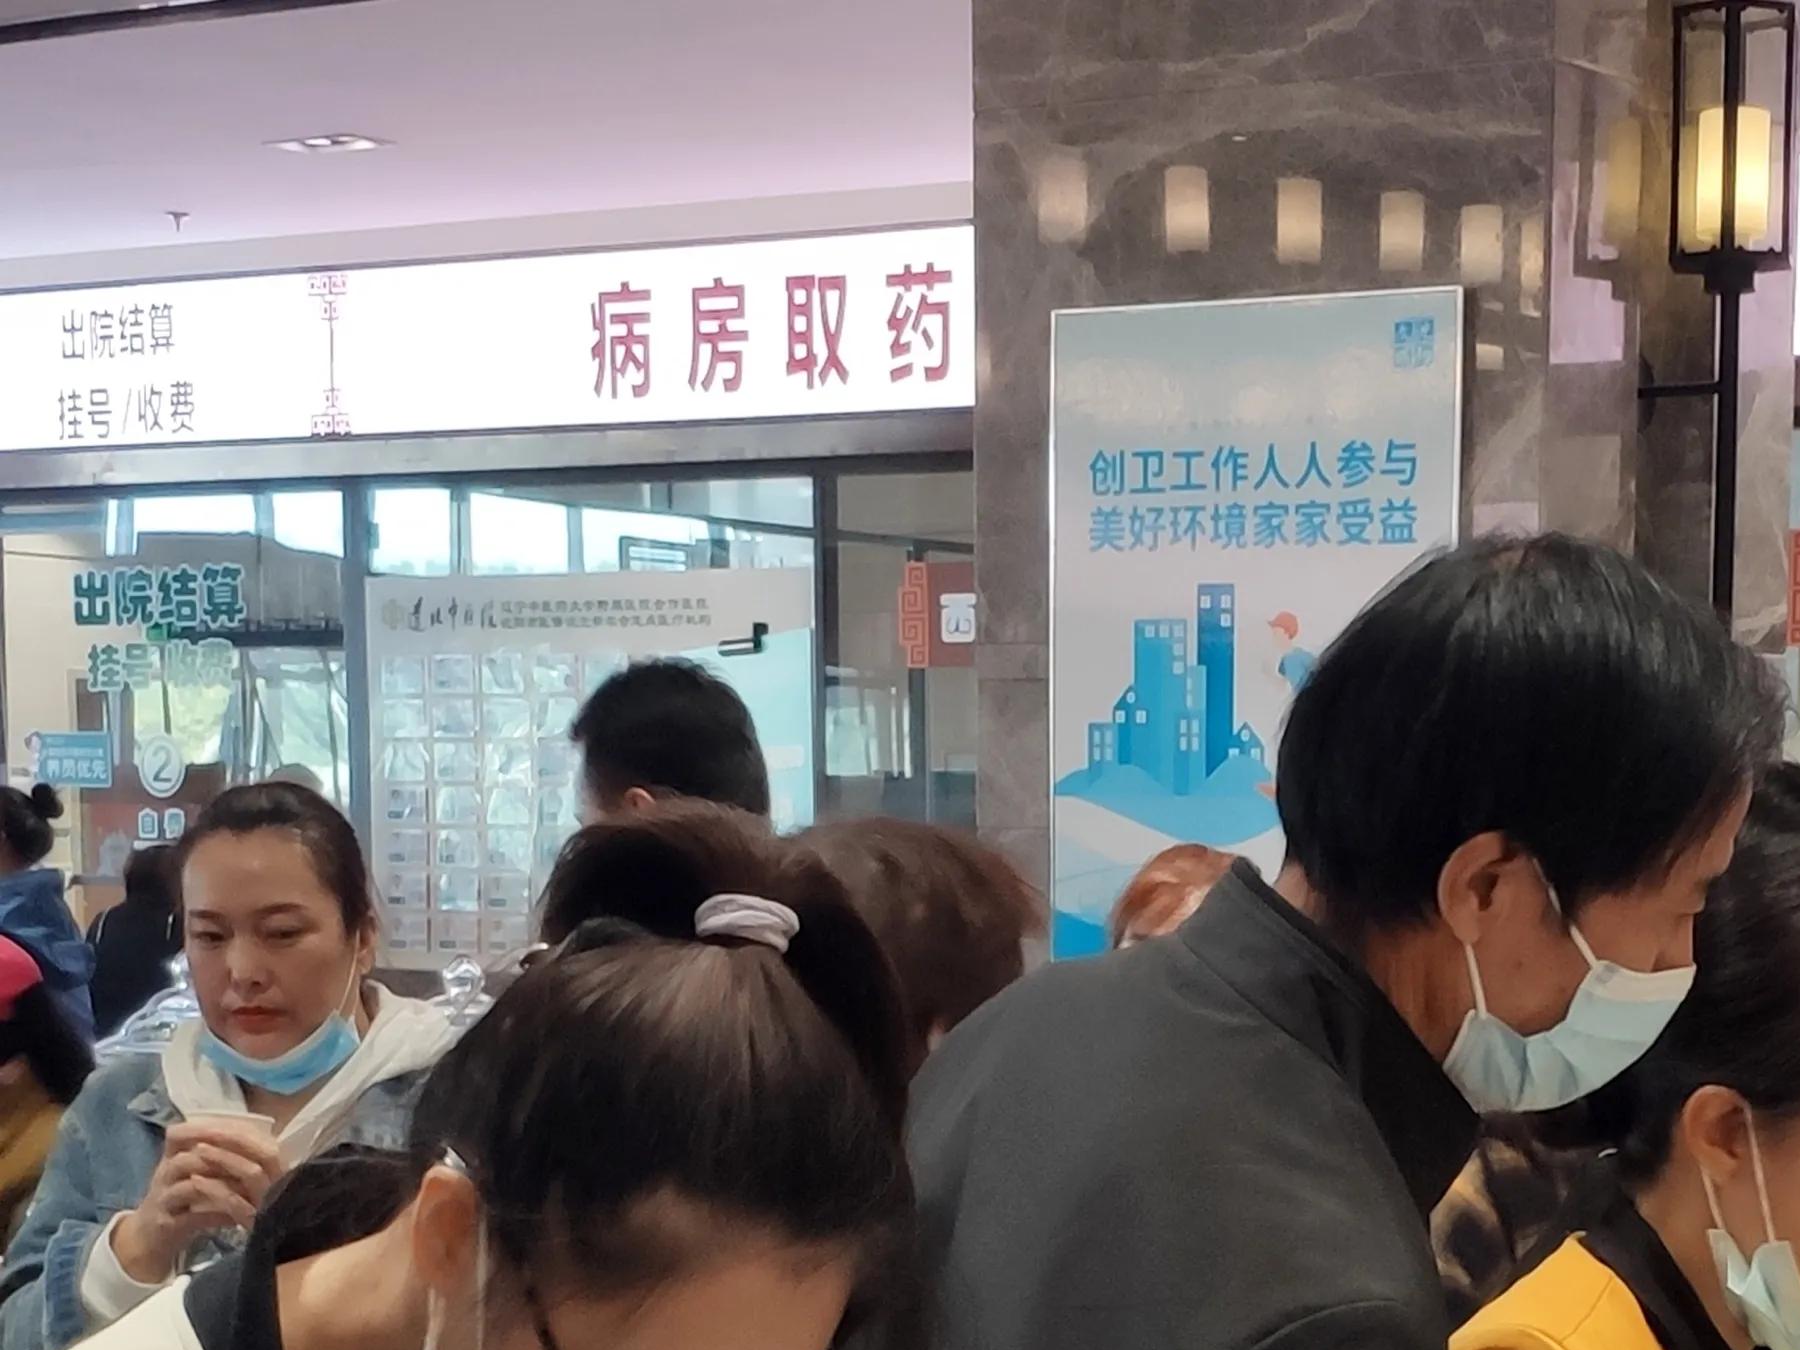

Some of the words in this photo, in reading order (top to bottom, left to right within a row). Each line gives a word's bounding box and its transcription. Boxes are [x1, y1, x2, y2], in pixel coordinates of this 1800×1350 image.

[61, 302, 175, 361] 出院结算
[590, 262, 953, 399] 病房取药
[57, 380, 195, 441] 挂号/收费
[1088, 438, 1418, 496] 创卫工作人人参与
[1088, 497, 1418, 553] 美好环境家家受益
[73, 563, 245, 627] 出院结算
